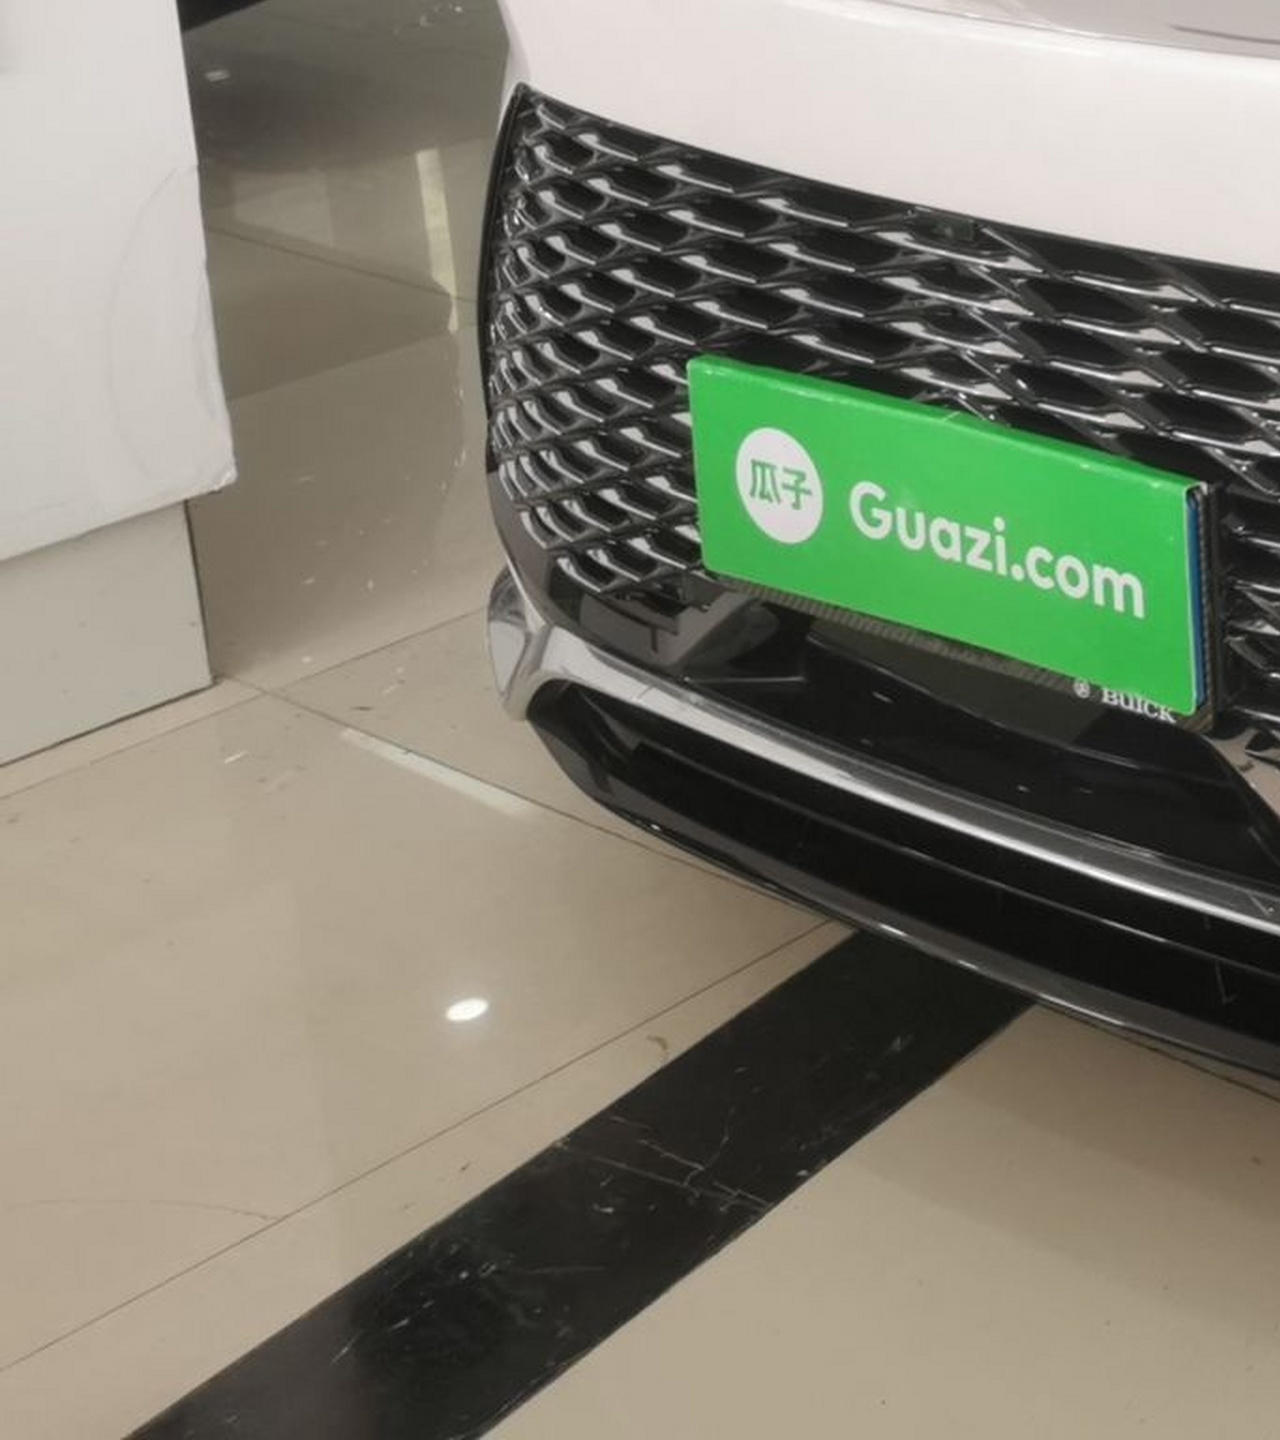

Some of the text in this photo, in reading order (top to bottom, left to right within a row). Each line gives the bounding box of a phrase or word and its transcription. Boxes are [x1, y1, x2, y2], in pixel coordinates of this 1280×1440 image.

[749, 459, 813, 510] 瓜子
[849, 480, 1145, 619] Guazi.com
[1101, 687, 1176, 724] BUICK
